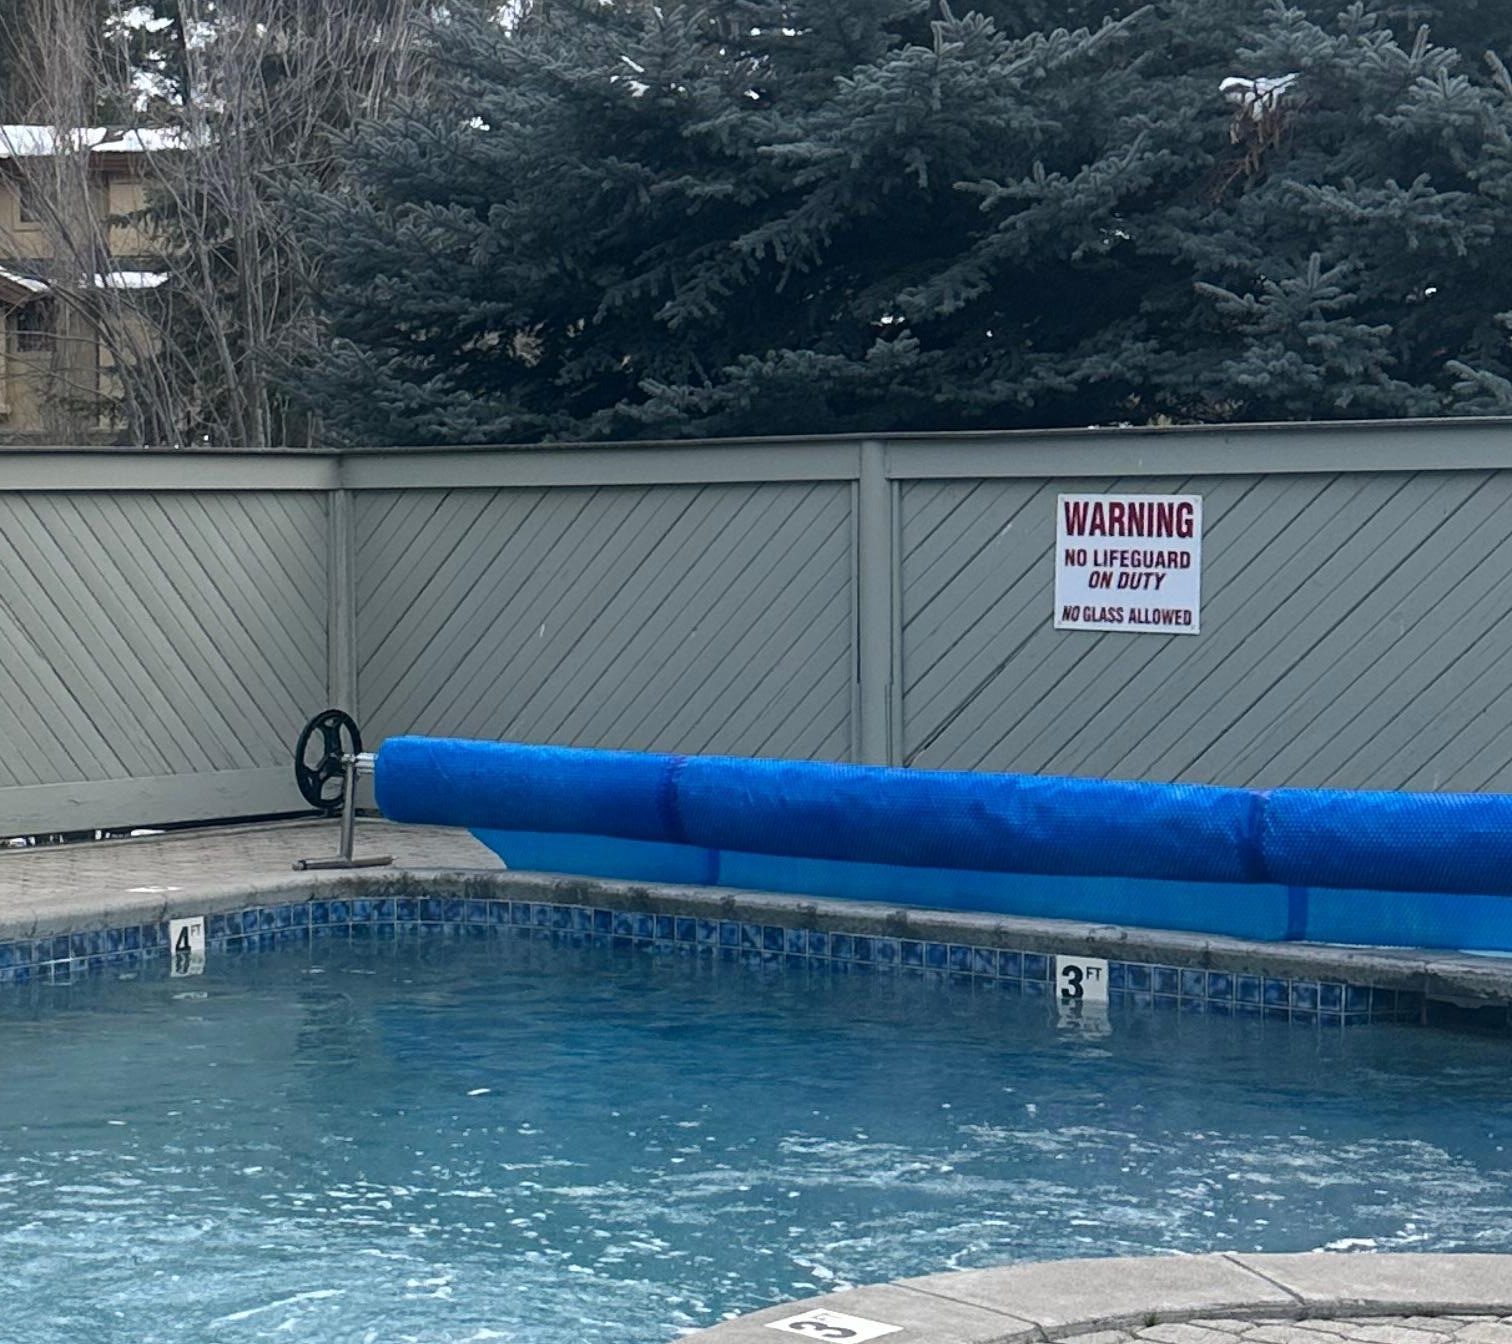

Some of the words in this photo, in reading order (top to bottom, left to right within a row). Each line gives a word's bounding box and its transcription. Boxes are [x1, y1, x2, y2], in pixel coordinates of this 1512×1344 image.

[1064, 501, 1194, 539] WARNING
[1064, 549, 1087, 567] NO
[1093, 549, 1191, 569] LIFEGUARD
[1088, 571, 1113, 589] ON
[1117, 572, 1166, 591] DUTY
[1062, 605, 1080, 622] NO
[1083, 607, 1124, 623] GLASS
[1128, 608, 1192, 626] ALLOWED
[176, 926, 191, 953] 4
[1061, 965, 1084, 998] 3
[1086, 966, 1103, 981] FT
[788, 1321, 857, 1338] 3
